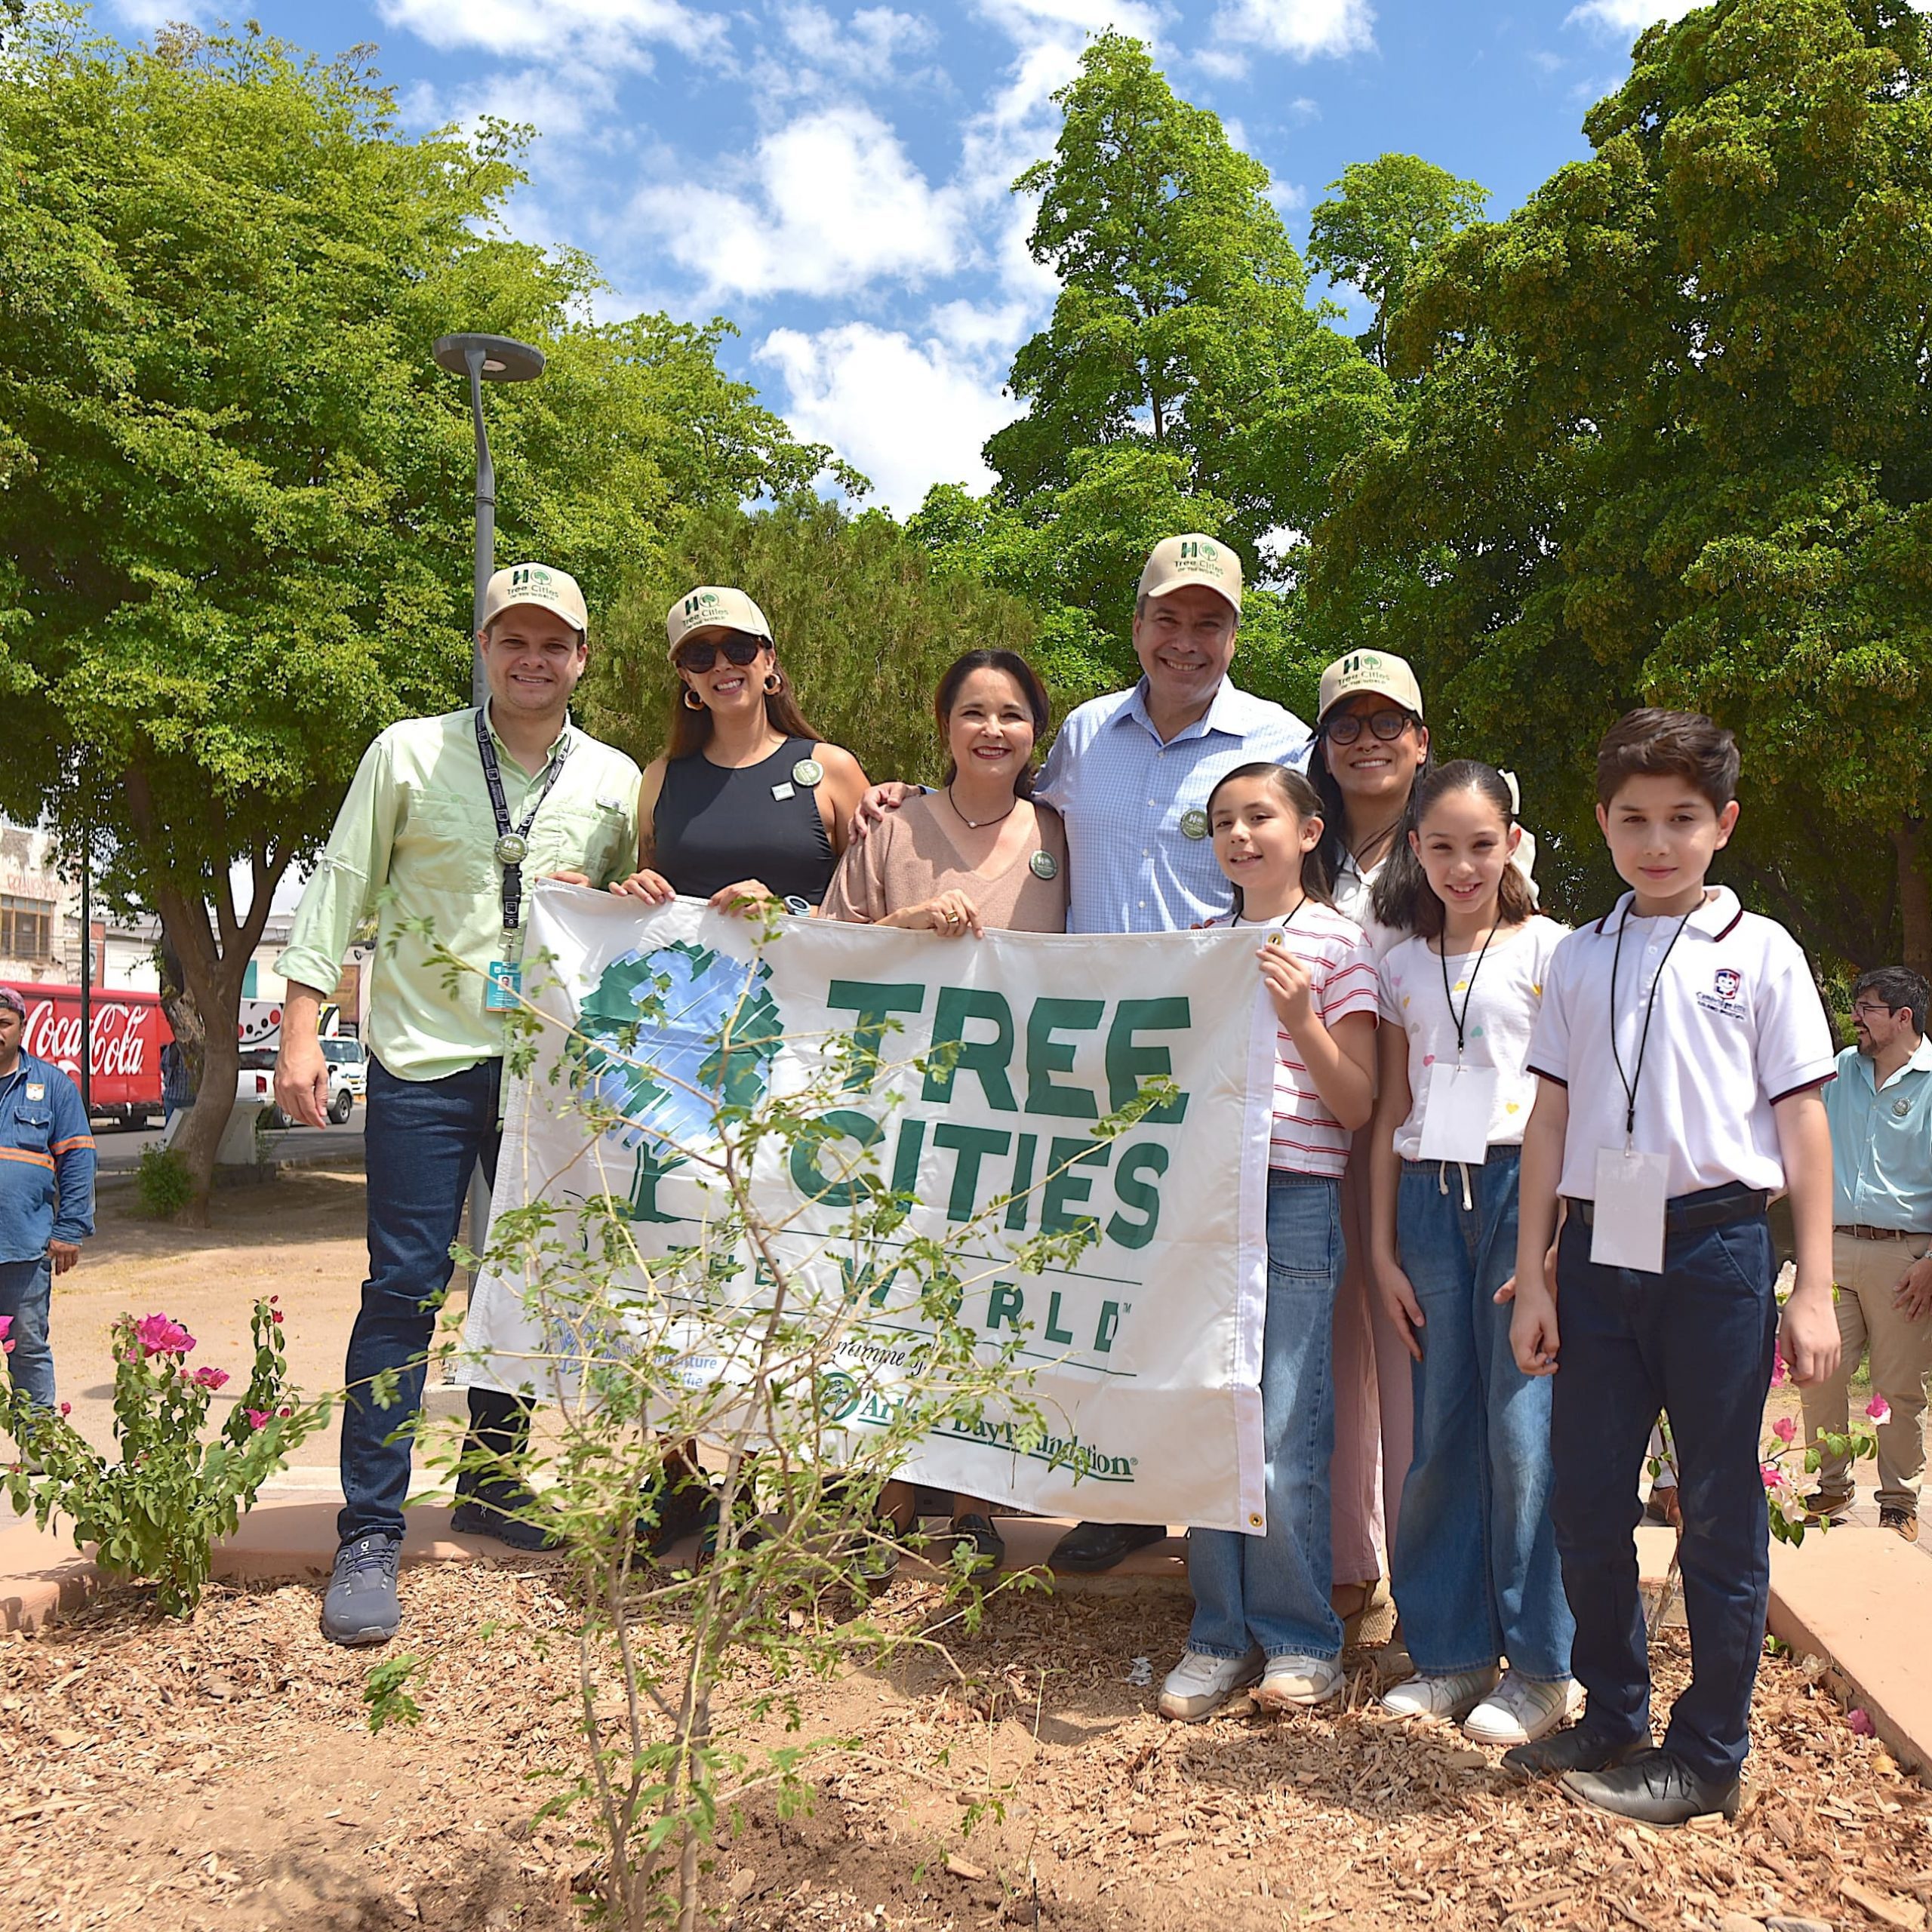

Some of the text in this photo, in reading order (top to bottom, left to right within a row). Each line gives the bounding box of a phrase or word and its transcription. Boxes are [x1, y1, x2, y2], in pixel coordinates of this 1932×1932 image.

[507, 585, 559, 598] Tree Cities
[826, 980, 1192, 1124] TREE
[790, 1110, 1169, 1250] CITIES
[1004, 1421, 1134, 1476] Fundtion
